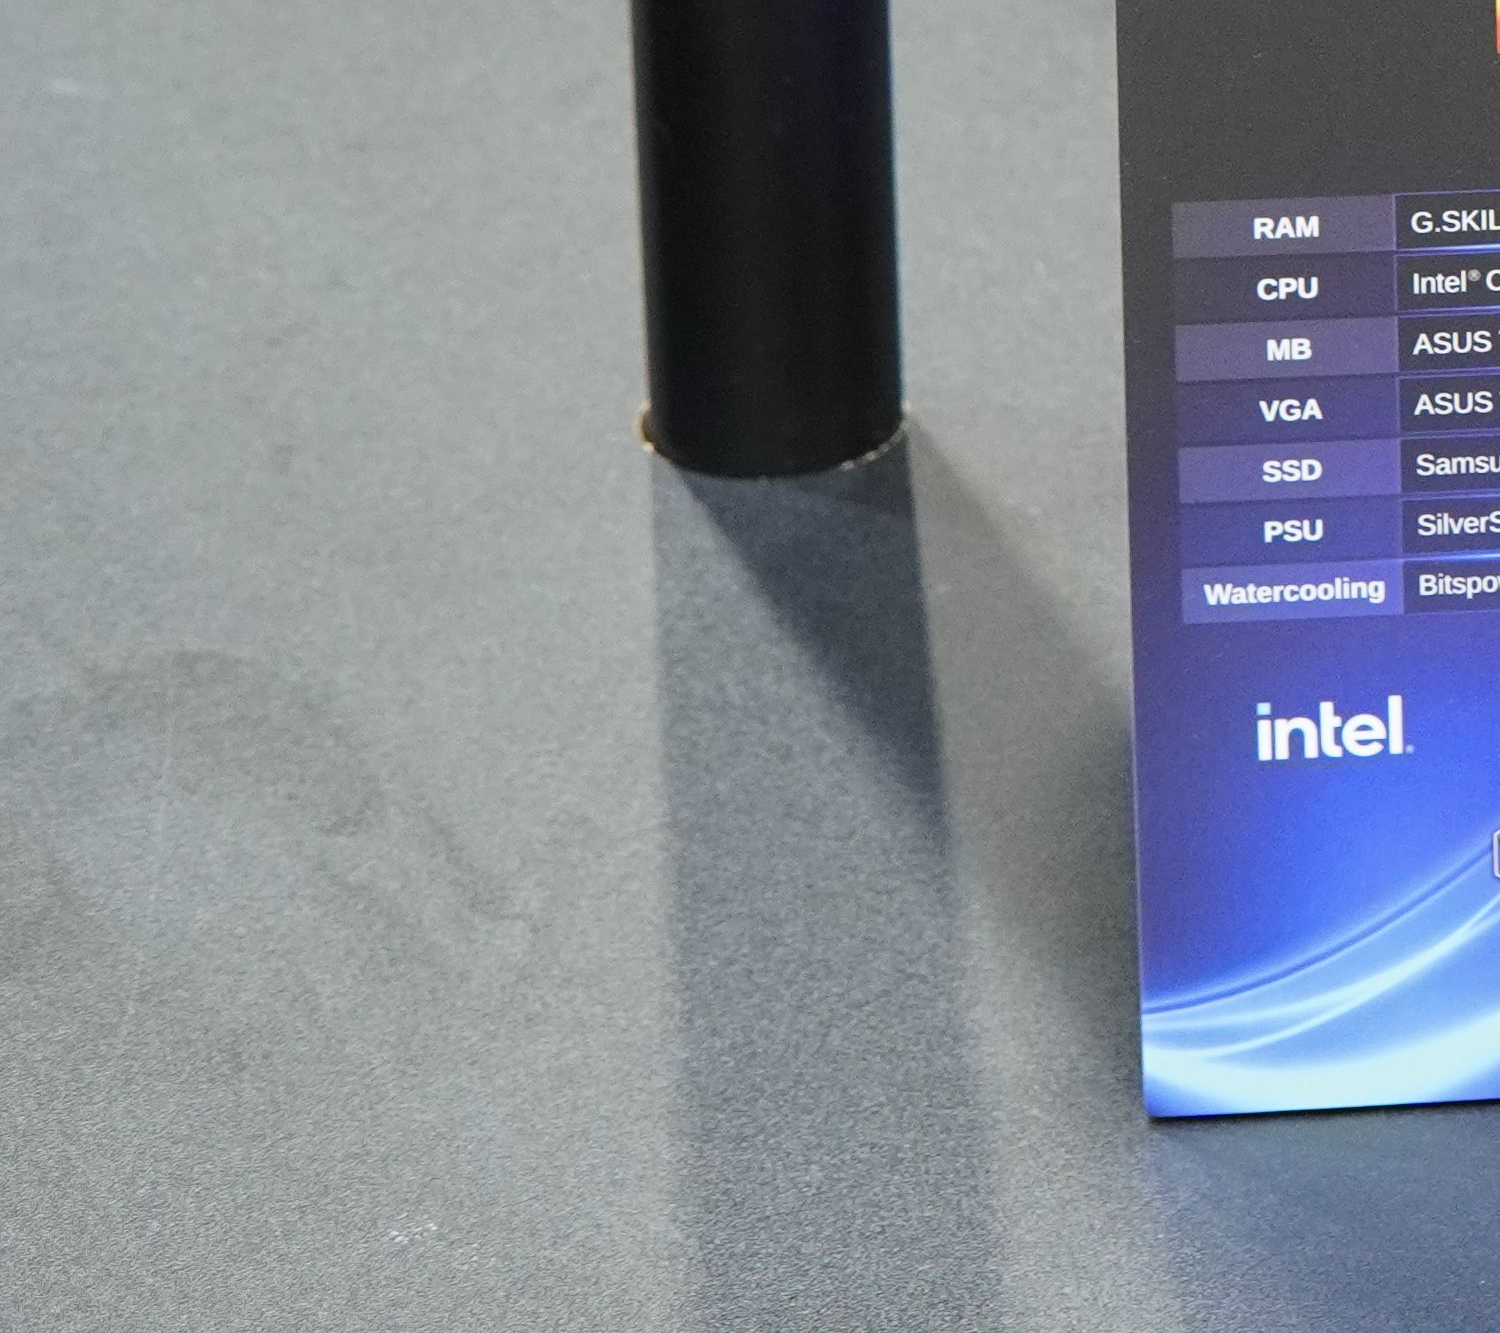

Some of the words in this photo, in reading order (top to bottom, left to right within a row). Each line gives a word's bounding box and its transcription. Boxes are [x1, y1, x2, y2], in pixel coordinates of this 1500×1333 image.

[1254, 216, 1319, 239] RAM
[1257, 277, 1318, 300] CPU
[1267, 338, 1312, 361] MB
[1413, 331, 1492, 354] ASUS
[1259, 399, 1323, 421] VGA
[1415, 391, 1493, 415] ASUS
[1263, 459, 1322, 482] SSD
[1264, 519, 1323, 542] PSU
[1204, 577, 1385, 605] Watercooling
[1255, 692, 1404, 763] intel
